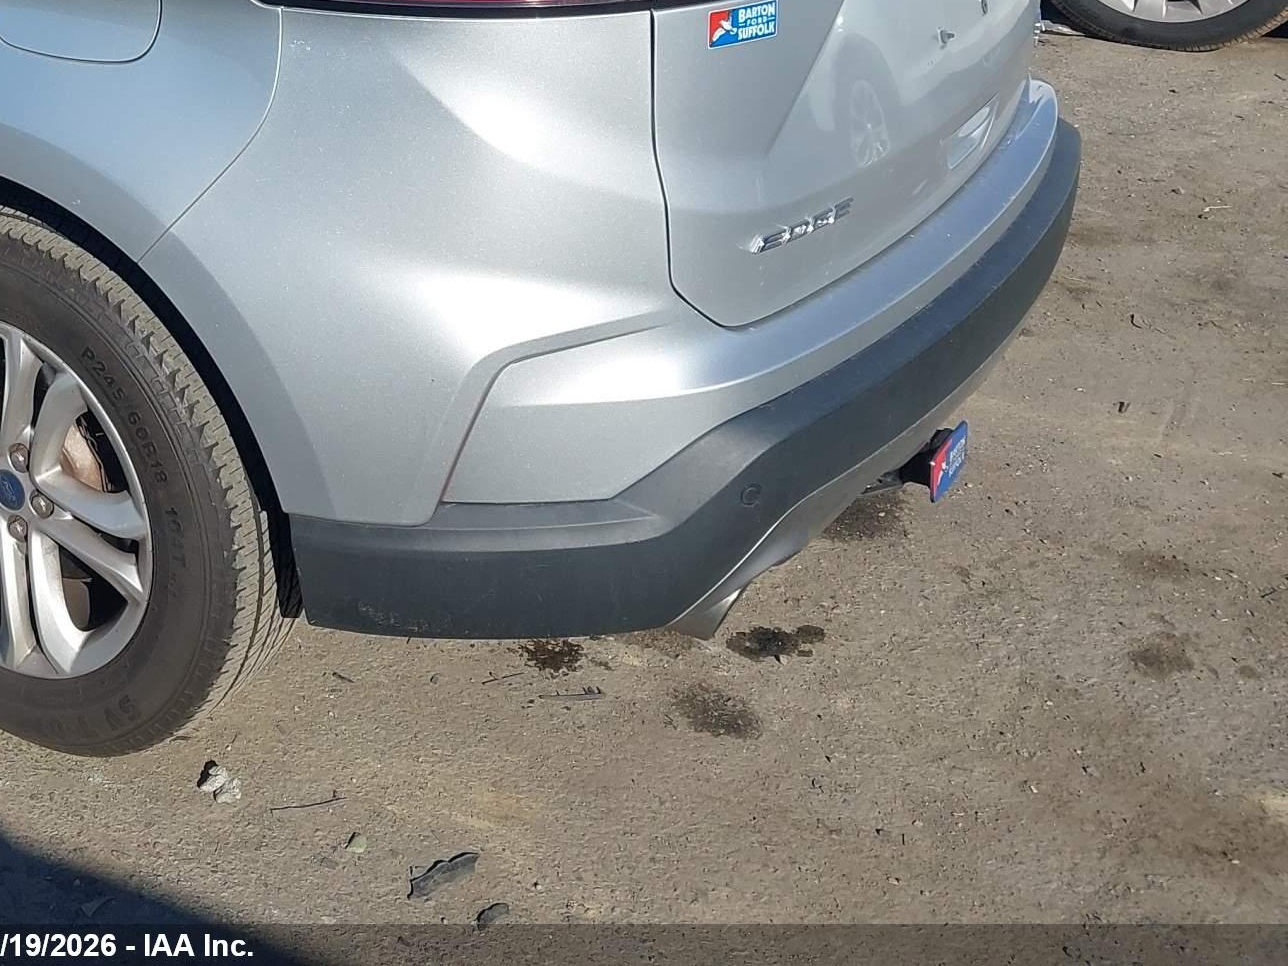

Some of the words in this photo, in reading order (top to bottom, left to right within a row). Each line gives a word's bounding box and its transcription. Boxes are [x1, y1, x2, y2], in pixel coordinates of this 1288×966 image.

[738, 2, 776, 23] BARTON
[747, 15, 767, 26] FORD
[737, 21, 775, 40] SUFFOLK
[750, 197, 854, 254] EDGE
